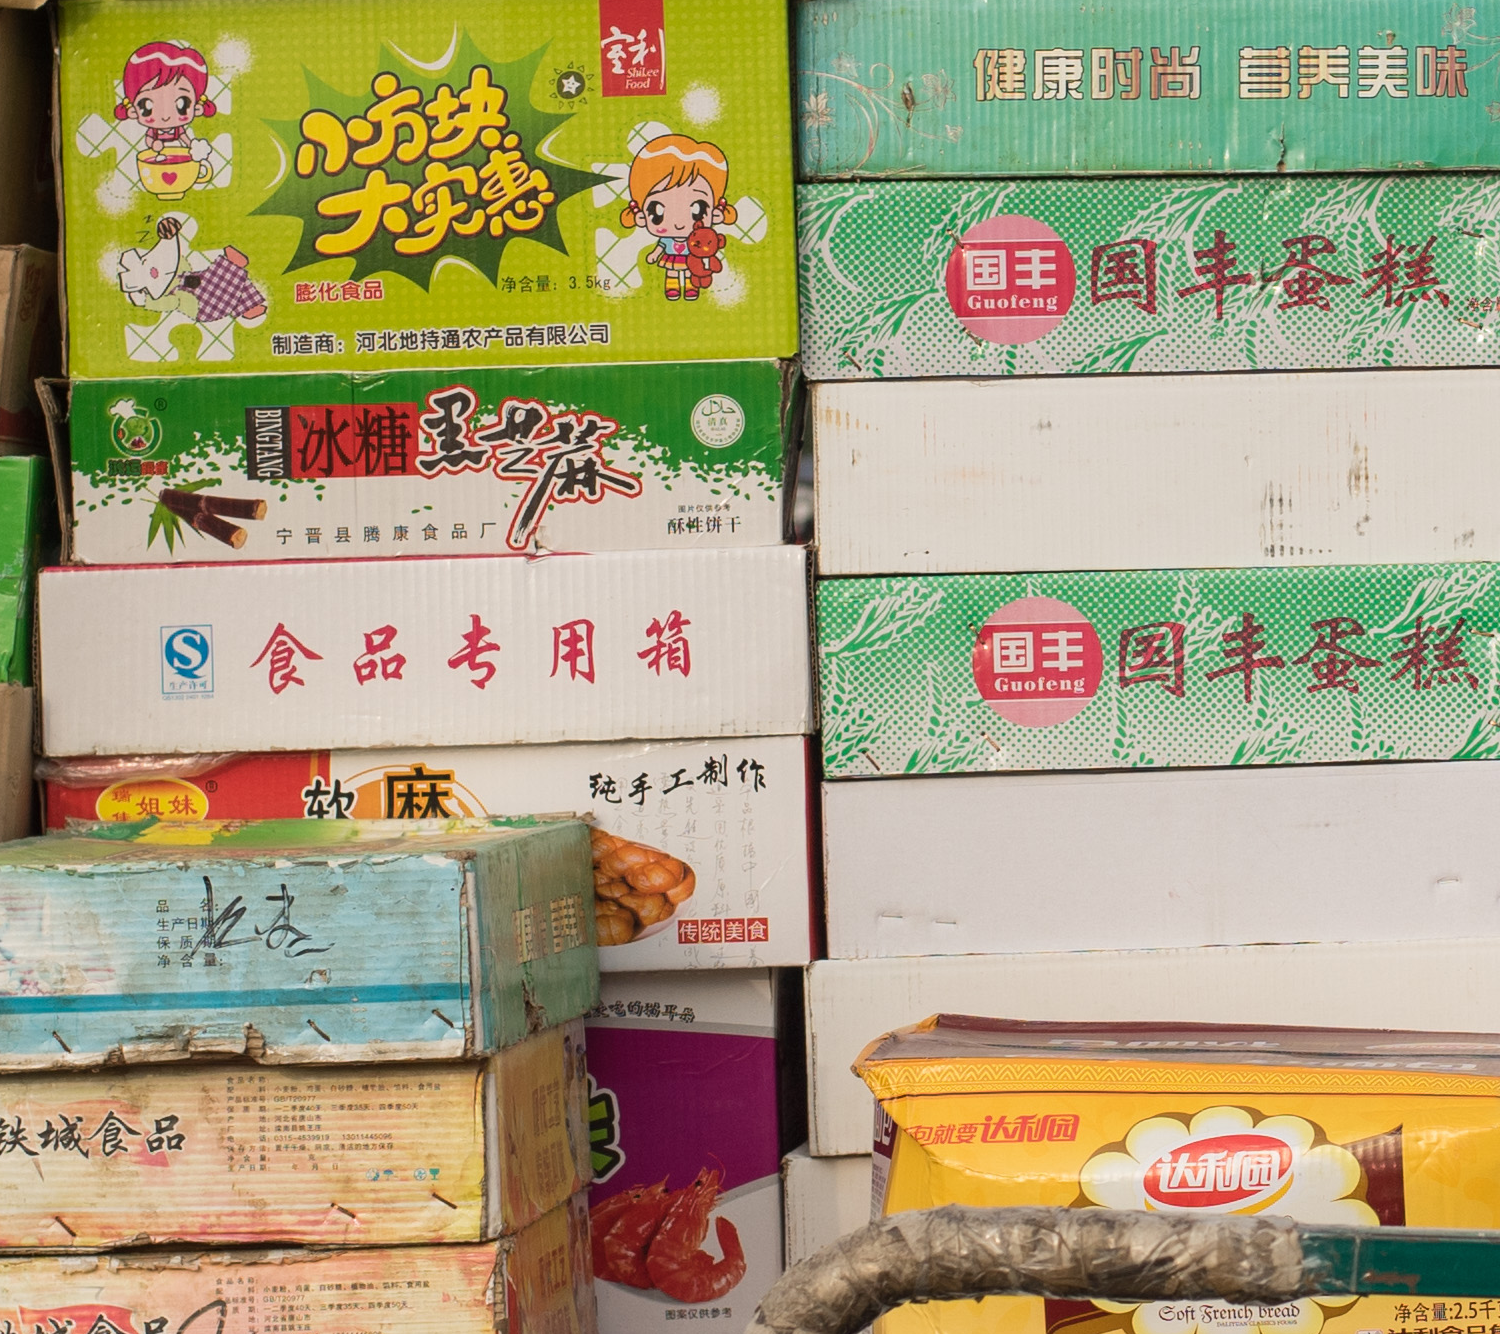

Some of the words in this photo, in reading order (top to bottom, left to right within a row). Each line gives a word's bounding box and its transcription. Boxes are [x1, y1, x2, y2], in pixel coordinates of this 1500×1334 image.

[625, 78, 651, 90] Food
[975, 48, 1201, 101] 健康时尚
[1239, 46, 1469, 99] 营养美味
[315, 148, 556, 255] 大实惠
[965, 248, 1058, 291] 国丰
[1092, 230, 1452, 320] 国丰蛋糕
[295, 281, 384, 303] 膨化食品
[967, 293, 1058, 312] Guofeng
[252, 409, 283, 477] BINGTANG
[708, 417, 727, 426] 清真
[297, 410, 412, 476] 冰糖
[417, 387, 641, 549] 黑芝麻
[276, 522, 497, 544] 宁晋县腾康食品厂
[668, 516, 741, 534] 酥性饼干
[251, 610, 693, 696] 食品专用箱
[993, 631, 1086, 674] 国丰
[1119, 612, 1480, 703] 国丰蛋糕
[995, 675, 1086, 694] Guofeng
[589, 757, 766, 803] 纯手工制作
[135, 794, 198, 818] 姐妹
[678, 918, 769, 944] 传统美食
[1158, 1148, 1281, 1193] 达利园
[1158, 1304, 1195, 1322] Soft
[1258, 1303, 1300, 1319] bread
